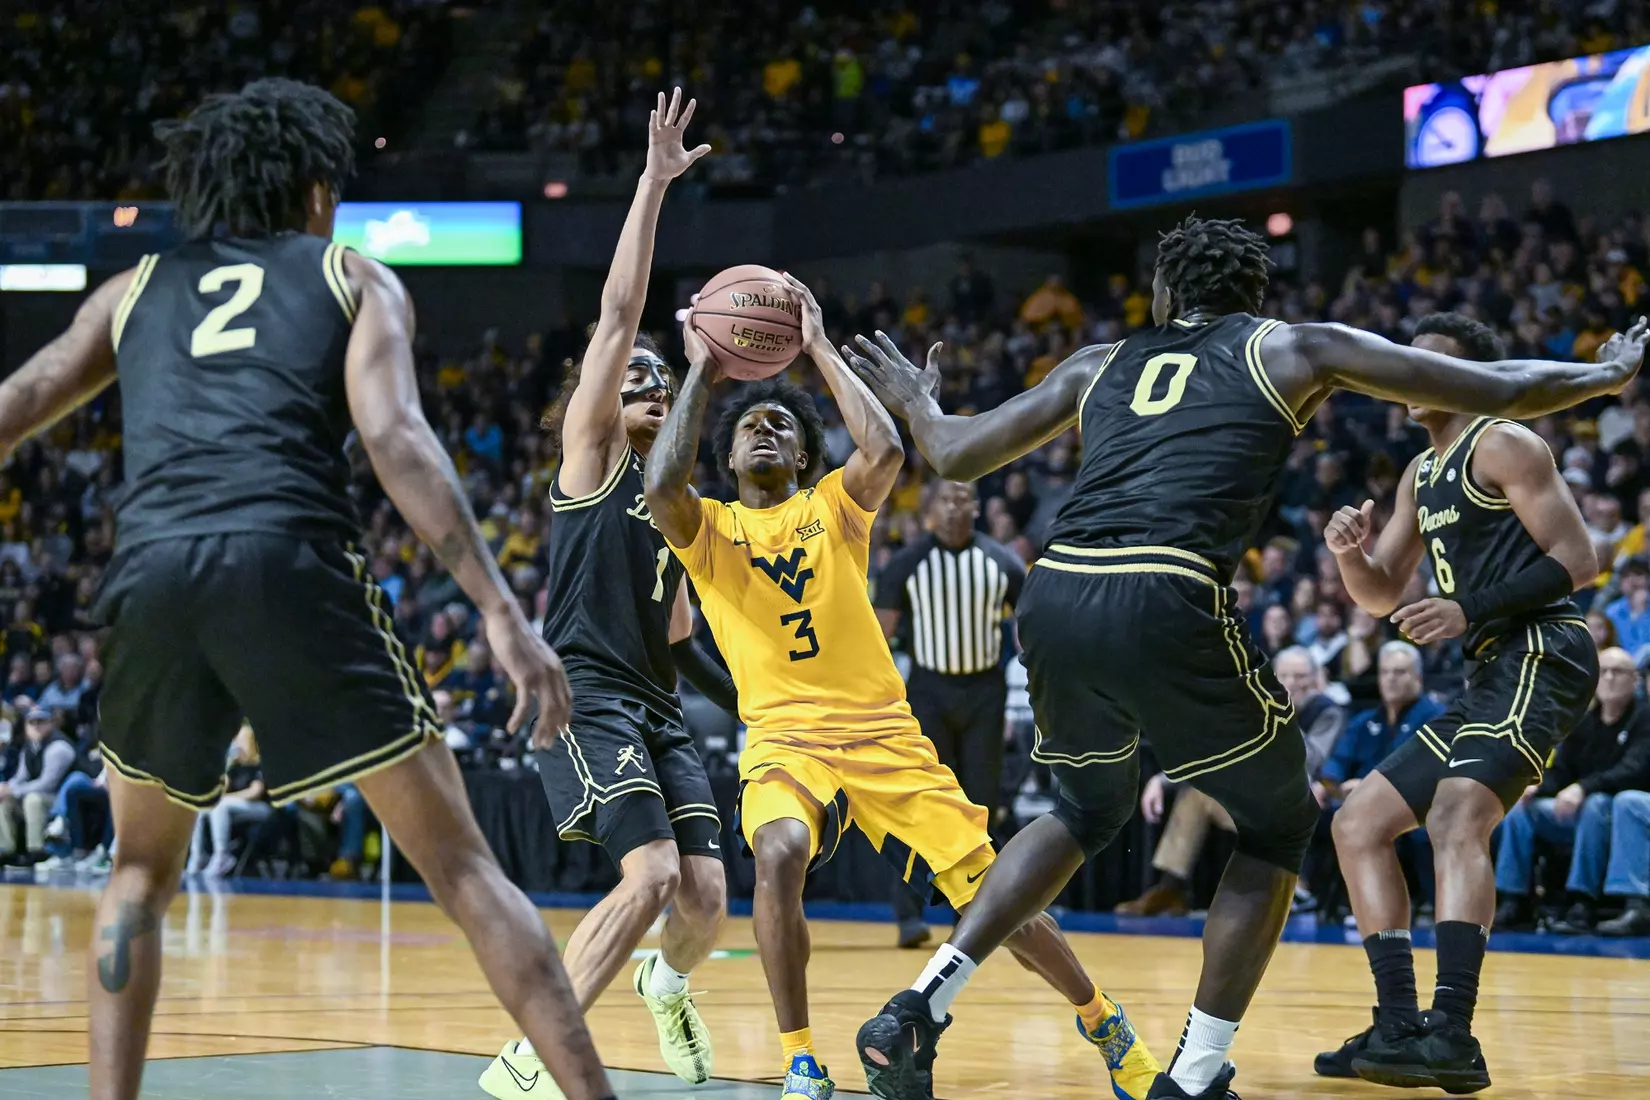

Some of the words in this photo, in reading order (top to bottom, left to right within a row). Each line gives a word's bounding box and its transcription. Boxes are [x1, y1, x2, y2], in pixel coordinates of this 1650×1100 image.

[191, 263, 264, 357] 2
[731, 323, 794, 345] LEGACY
[1129, 352, 1199, 416] 0
[651, 546, 670, 602] 1
[1431, 537, 1455, 594] 6
[780, 609, 820, 662] 3
